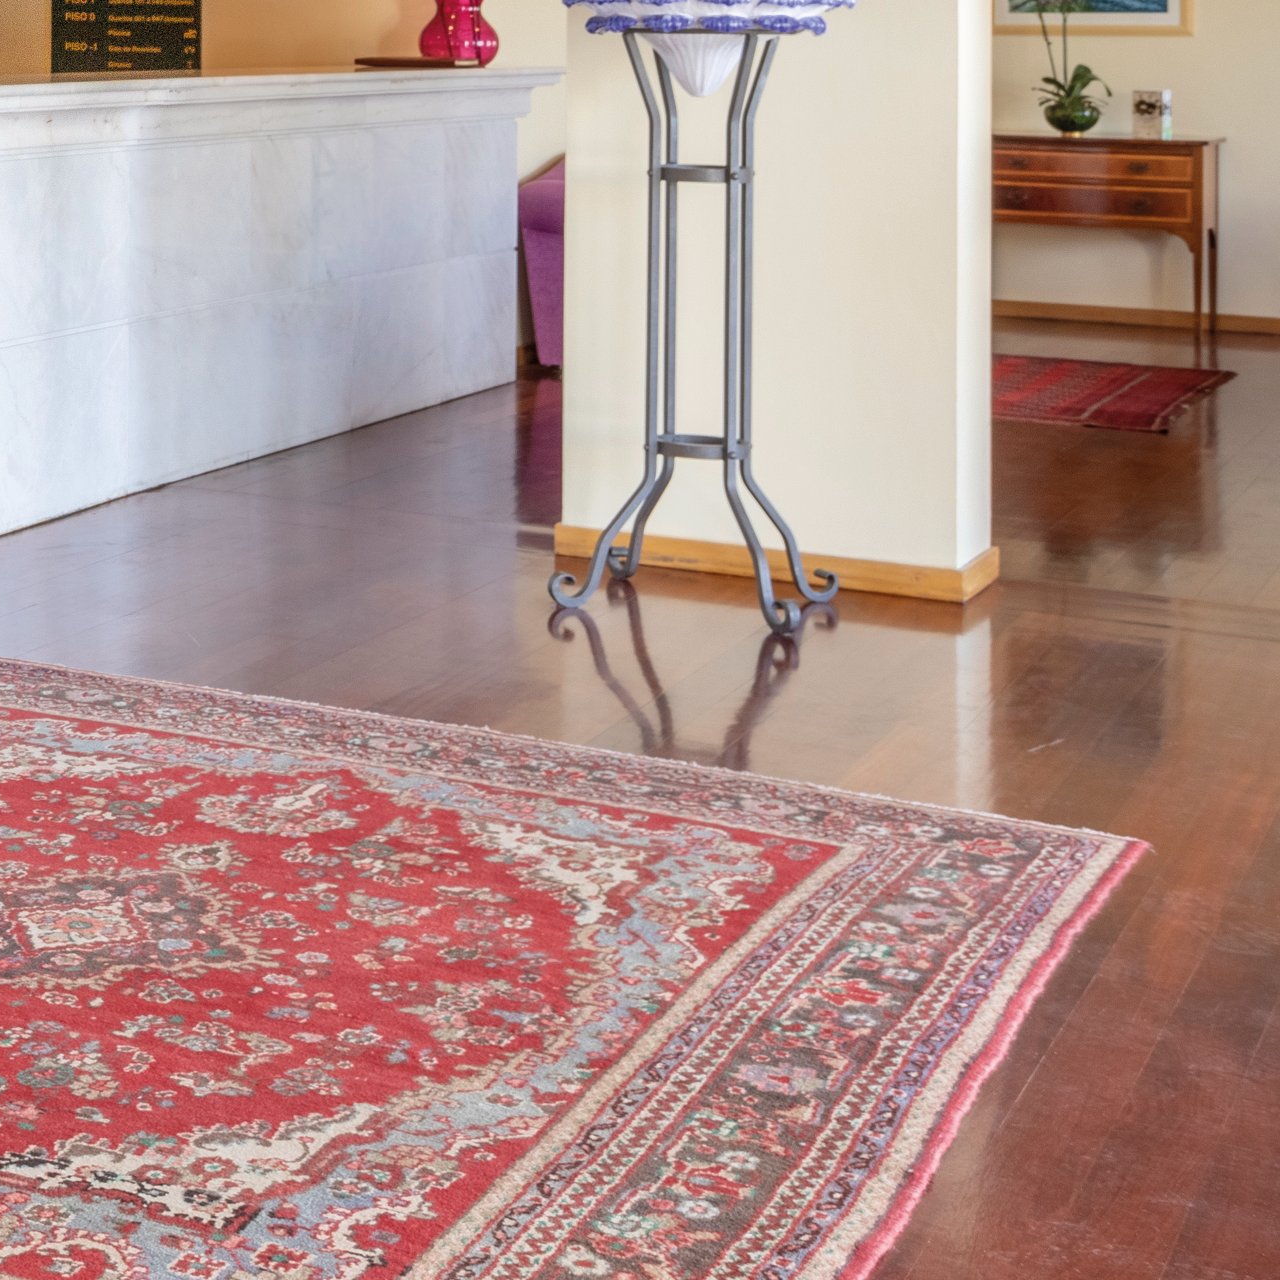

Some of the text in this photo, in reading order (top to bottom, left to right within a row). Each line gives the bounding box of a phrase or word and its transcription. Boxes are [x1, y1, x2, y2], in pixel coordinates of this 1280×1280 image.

[64, 12, 88, 21] PISO
[90, 12, 96, 21] 0
[64, 41, 88, 52] PISO
[90, 42, 98, 51] -1
